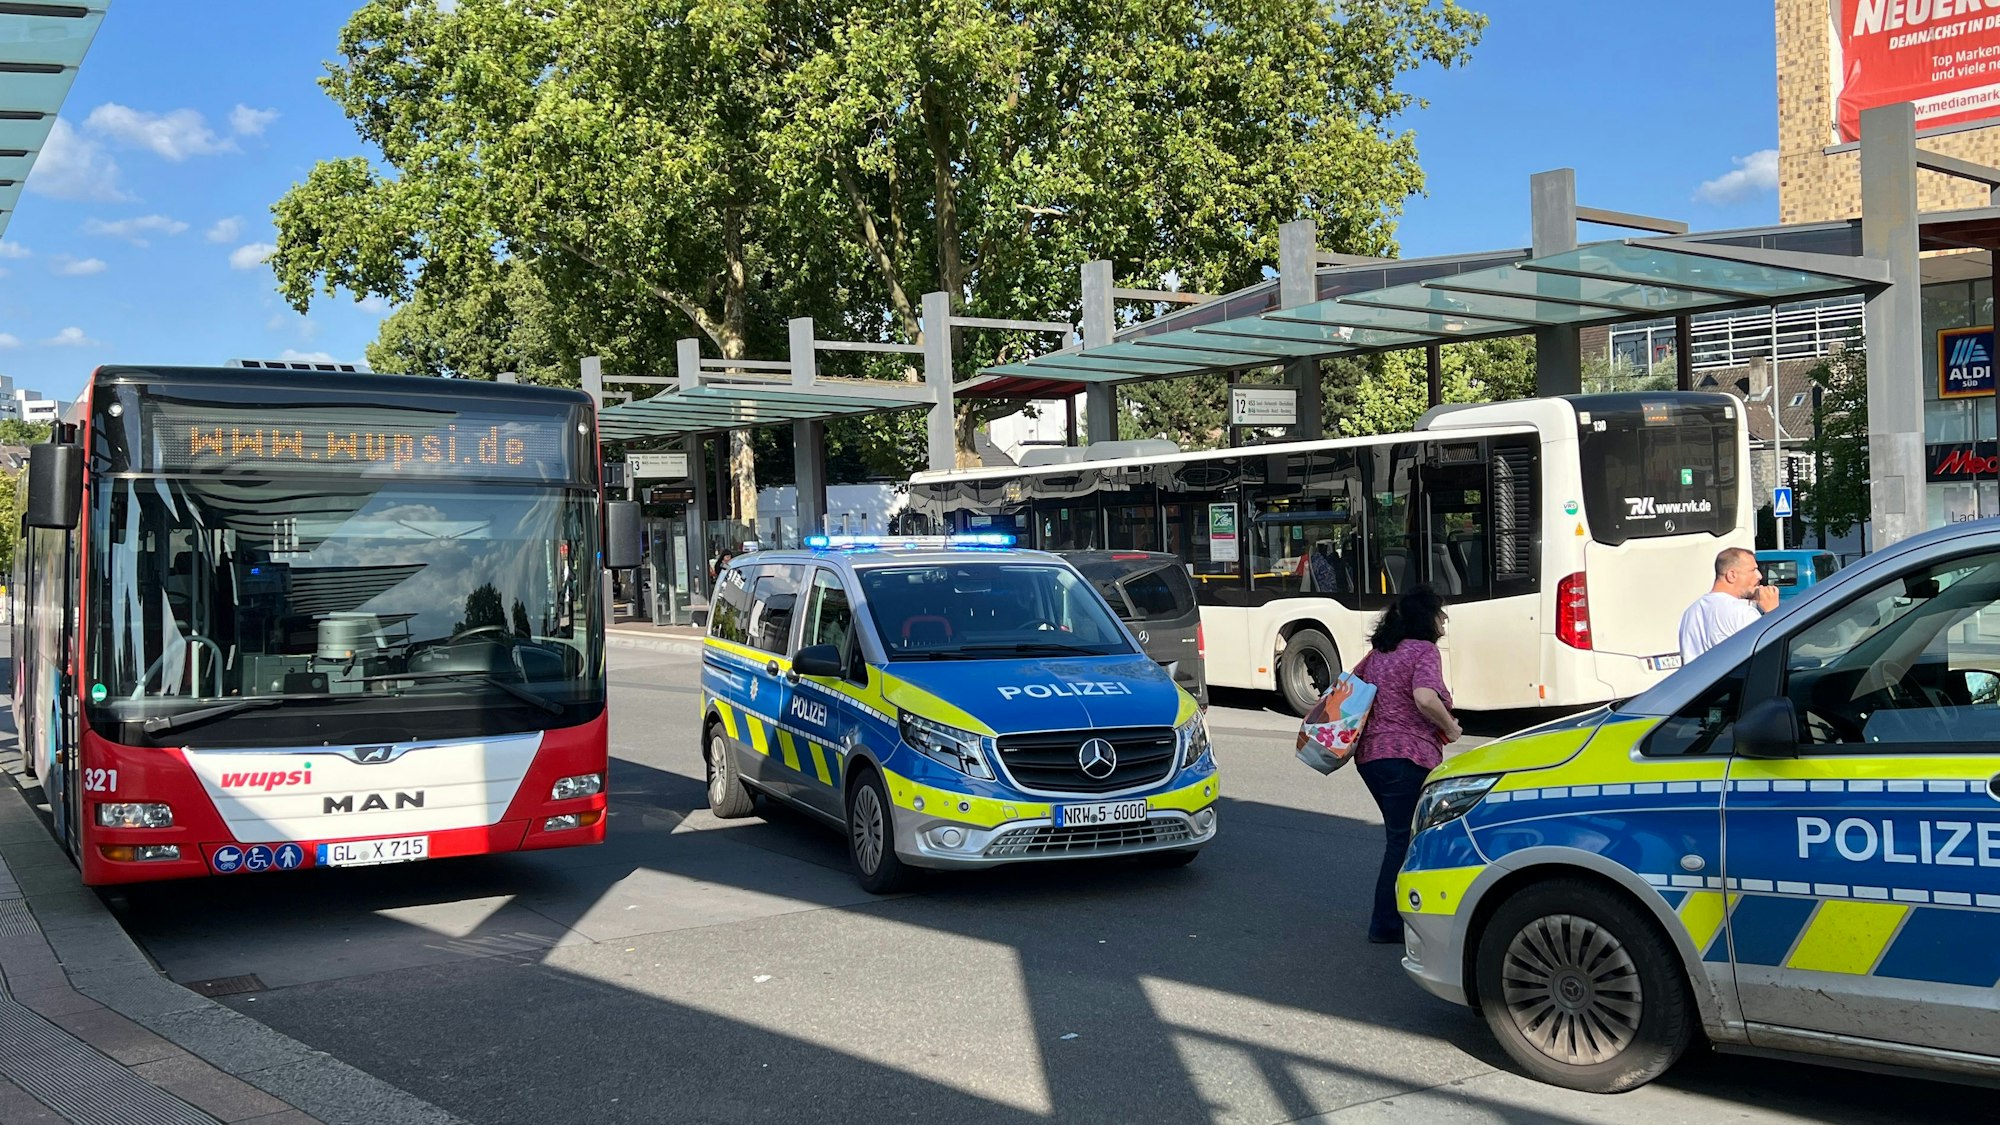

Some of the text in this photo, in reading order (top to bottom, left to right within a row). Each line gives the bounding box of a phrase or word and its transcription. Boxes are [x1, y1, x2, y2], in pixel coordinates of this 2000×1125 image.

[1888, 21, 1967, 50] DEMNÄCHST
[1967, 17, 1984, 34] IN
[1931, 45, 2000, 68] Top Marken
[1931, 68, 1955, 82] und
[1957, 61, 1986, 77] viele
[1949, 365, 1991, 380] ALDI
[1962, 379, 1979, 387] SÜD
[1236, 399, 1246, 414] 12
[1592, 420, 1607, 432] 130
[191, 424, 525, 470] www.wupsi.de
[1656, 499, 1711, 514] www.rvk.de
[997, 681, 1132, 700] POLIZEI
[791, 694, 827, 727] POLIZEI
[84, 767, 118, 793] 321
[220, 761, 312, 791] wupsi
[322, 790, 425, 814] MAN
[1099, 803, 1145, 822] 5-6000
[333, 838, 424, 862] GL X 715
[1796, 816, 2000, 868] POLIZE
